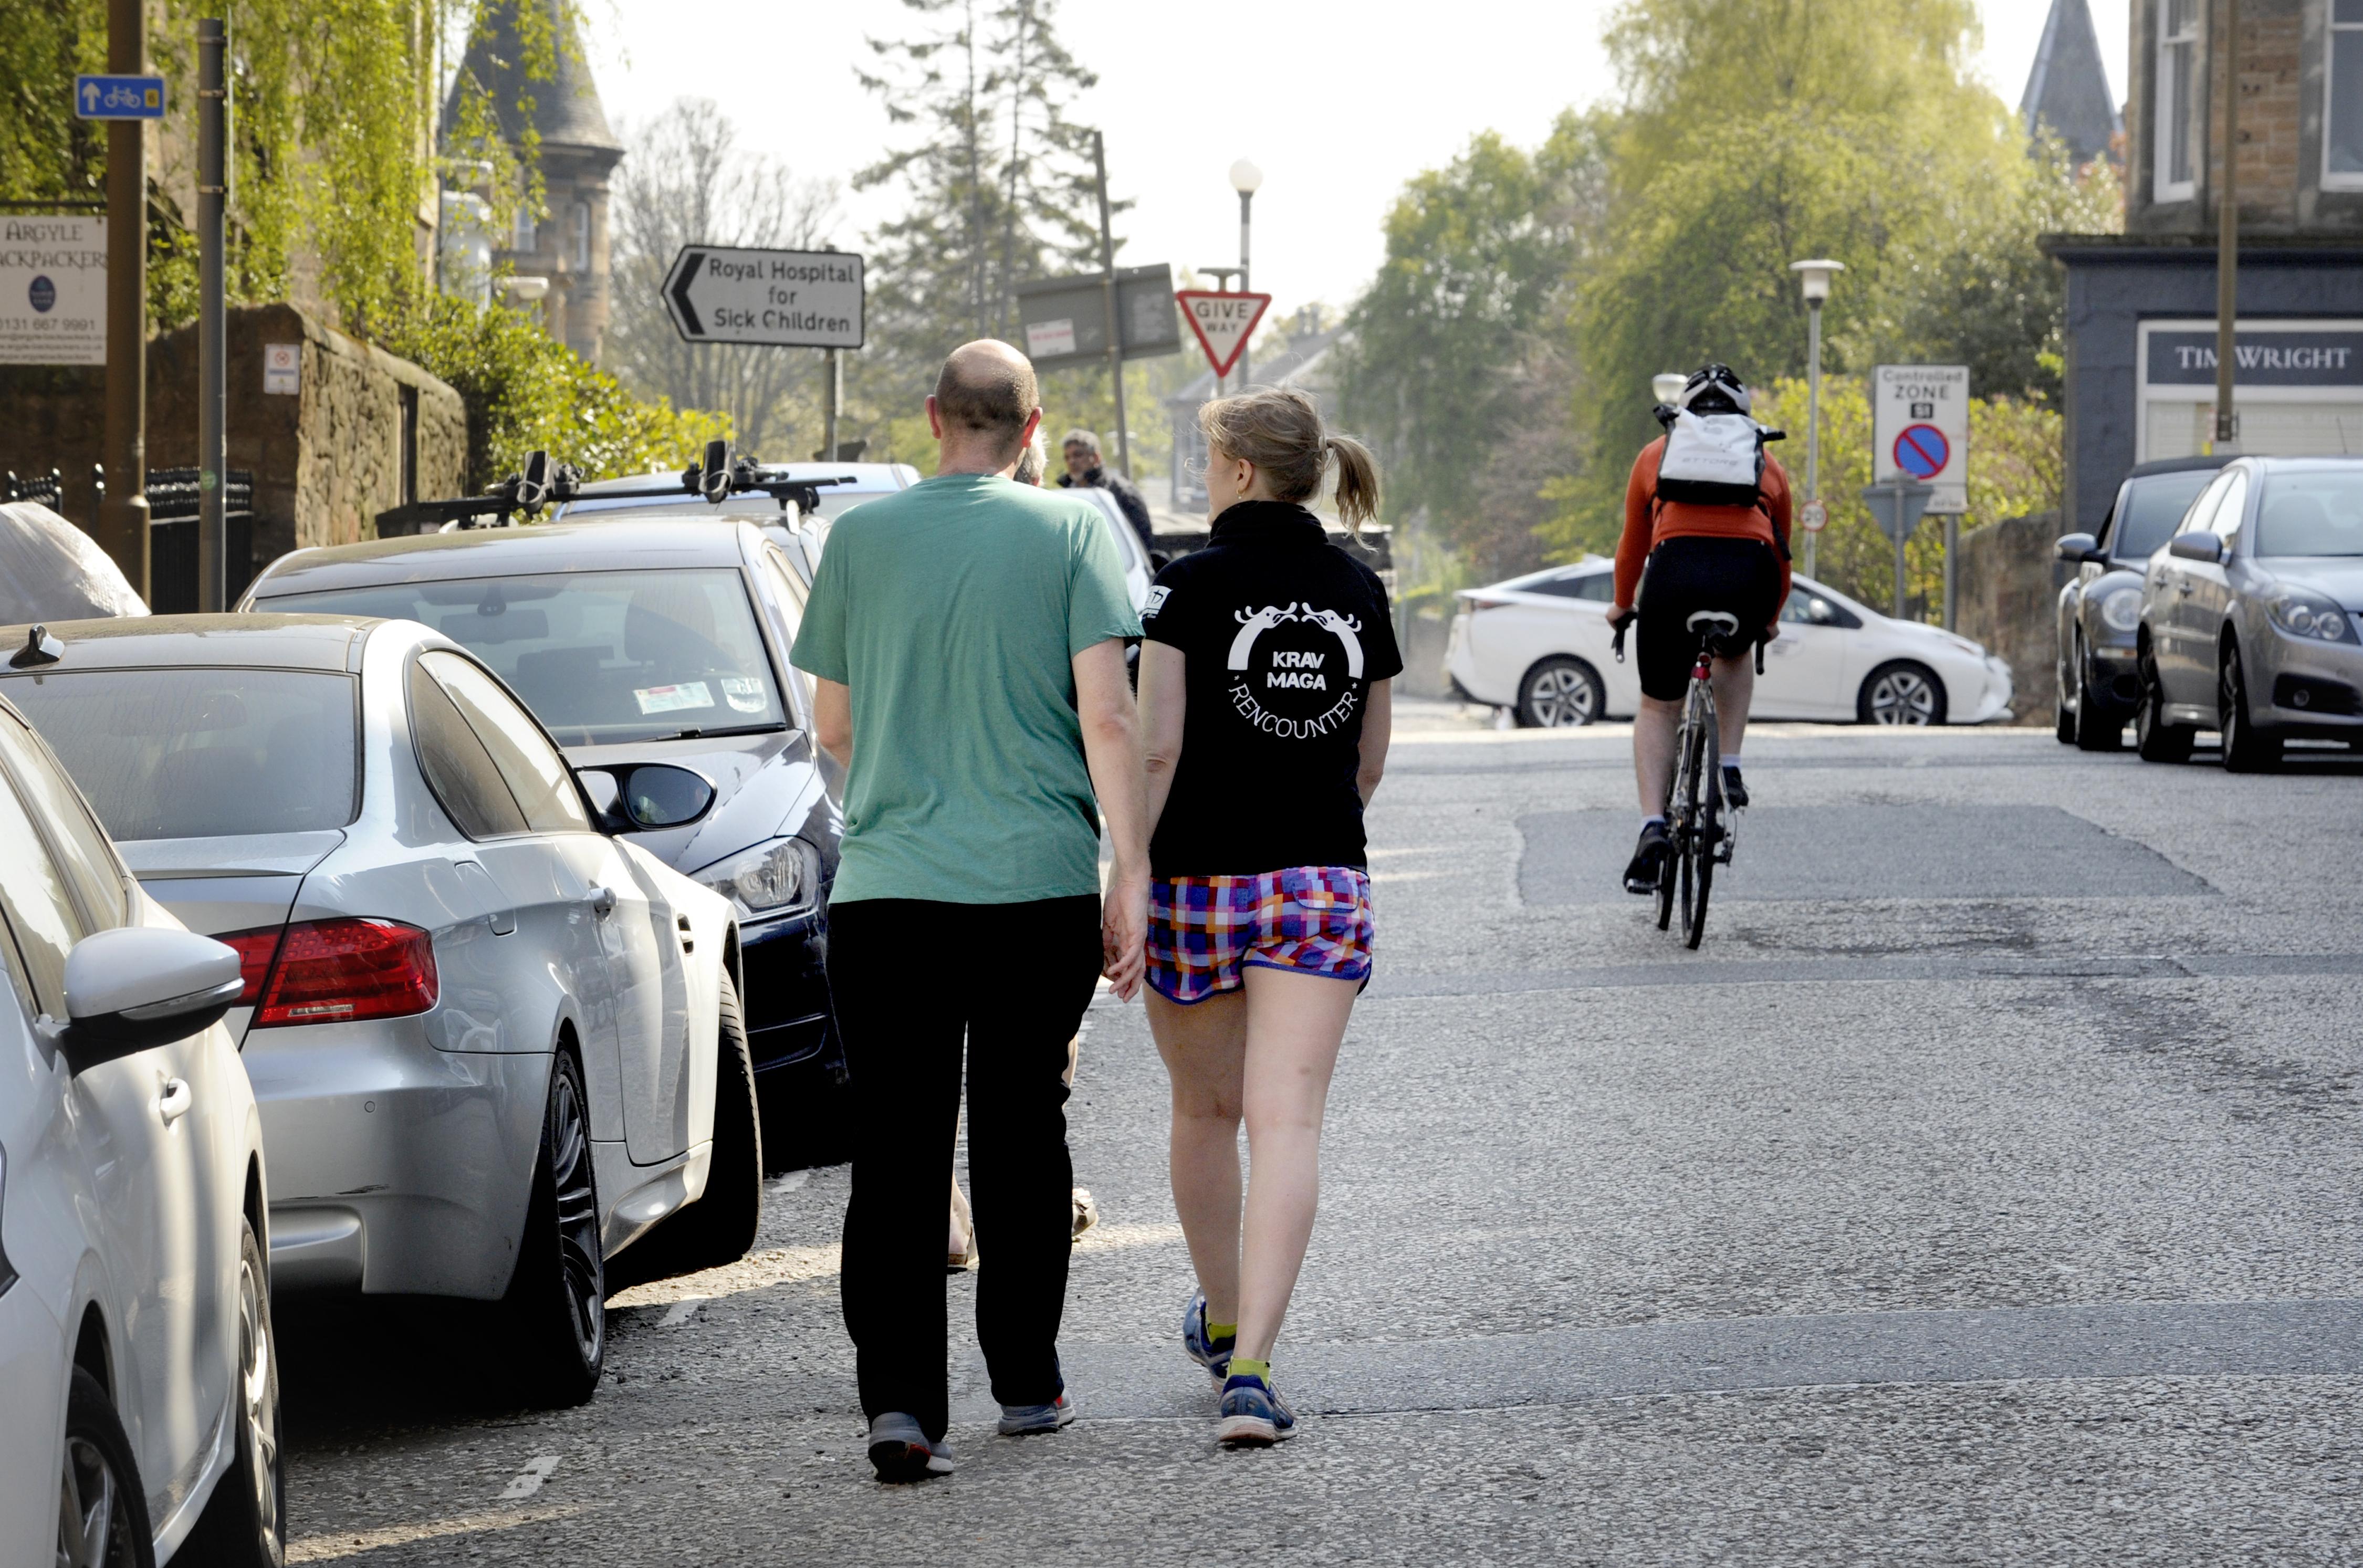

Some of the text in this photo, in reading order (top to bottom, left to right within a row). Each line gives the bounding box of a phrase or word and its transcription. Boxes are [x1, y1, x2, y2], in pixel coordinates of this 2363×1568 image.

[6, 219, 83, 243] ARGYLE
[709, 258, 854, 284] Royal Hospital
[768, 285, 797, 304] for
[714, 307, 850, 332] Sick Children
[1195, 301, 1248, 319] GIVE
[1206, 322, 1239, 332] WAY
[2234, 346, 2351, 369] WRIGHT
[1883, 370, 1963, 382] Controlled
[1894, 384, 1949, 401] ZONE
[1273, 651, 1325, 668] KRAV
[1267, 672, 1326, 691] MAGA
[1228, 683, 1358, 739] RENCOUNTER
